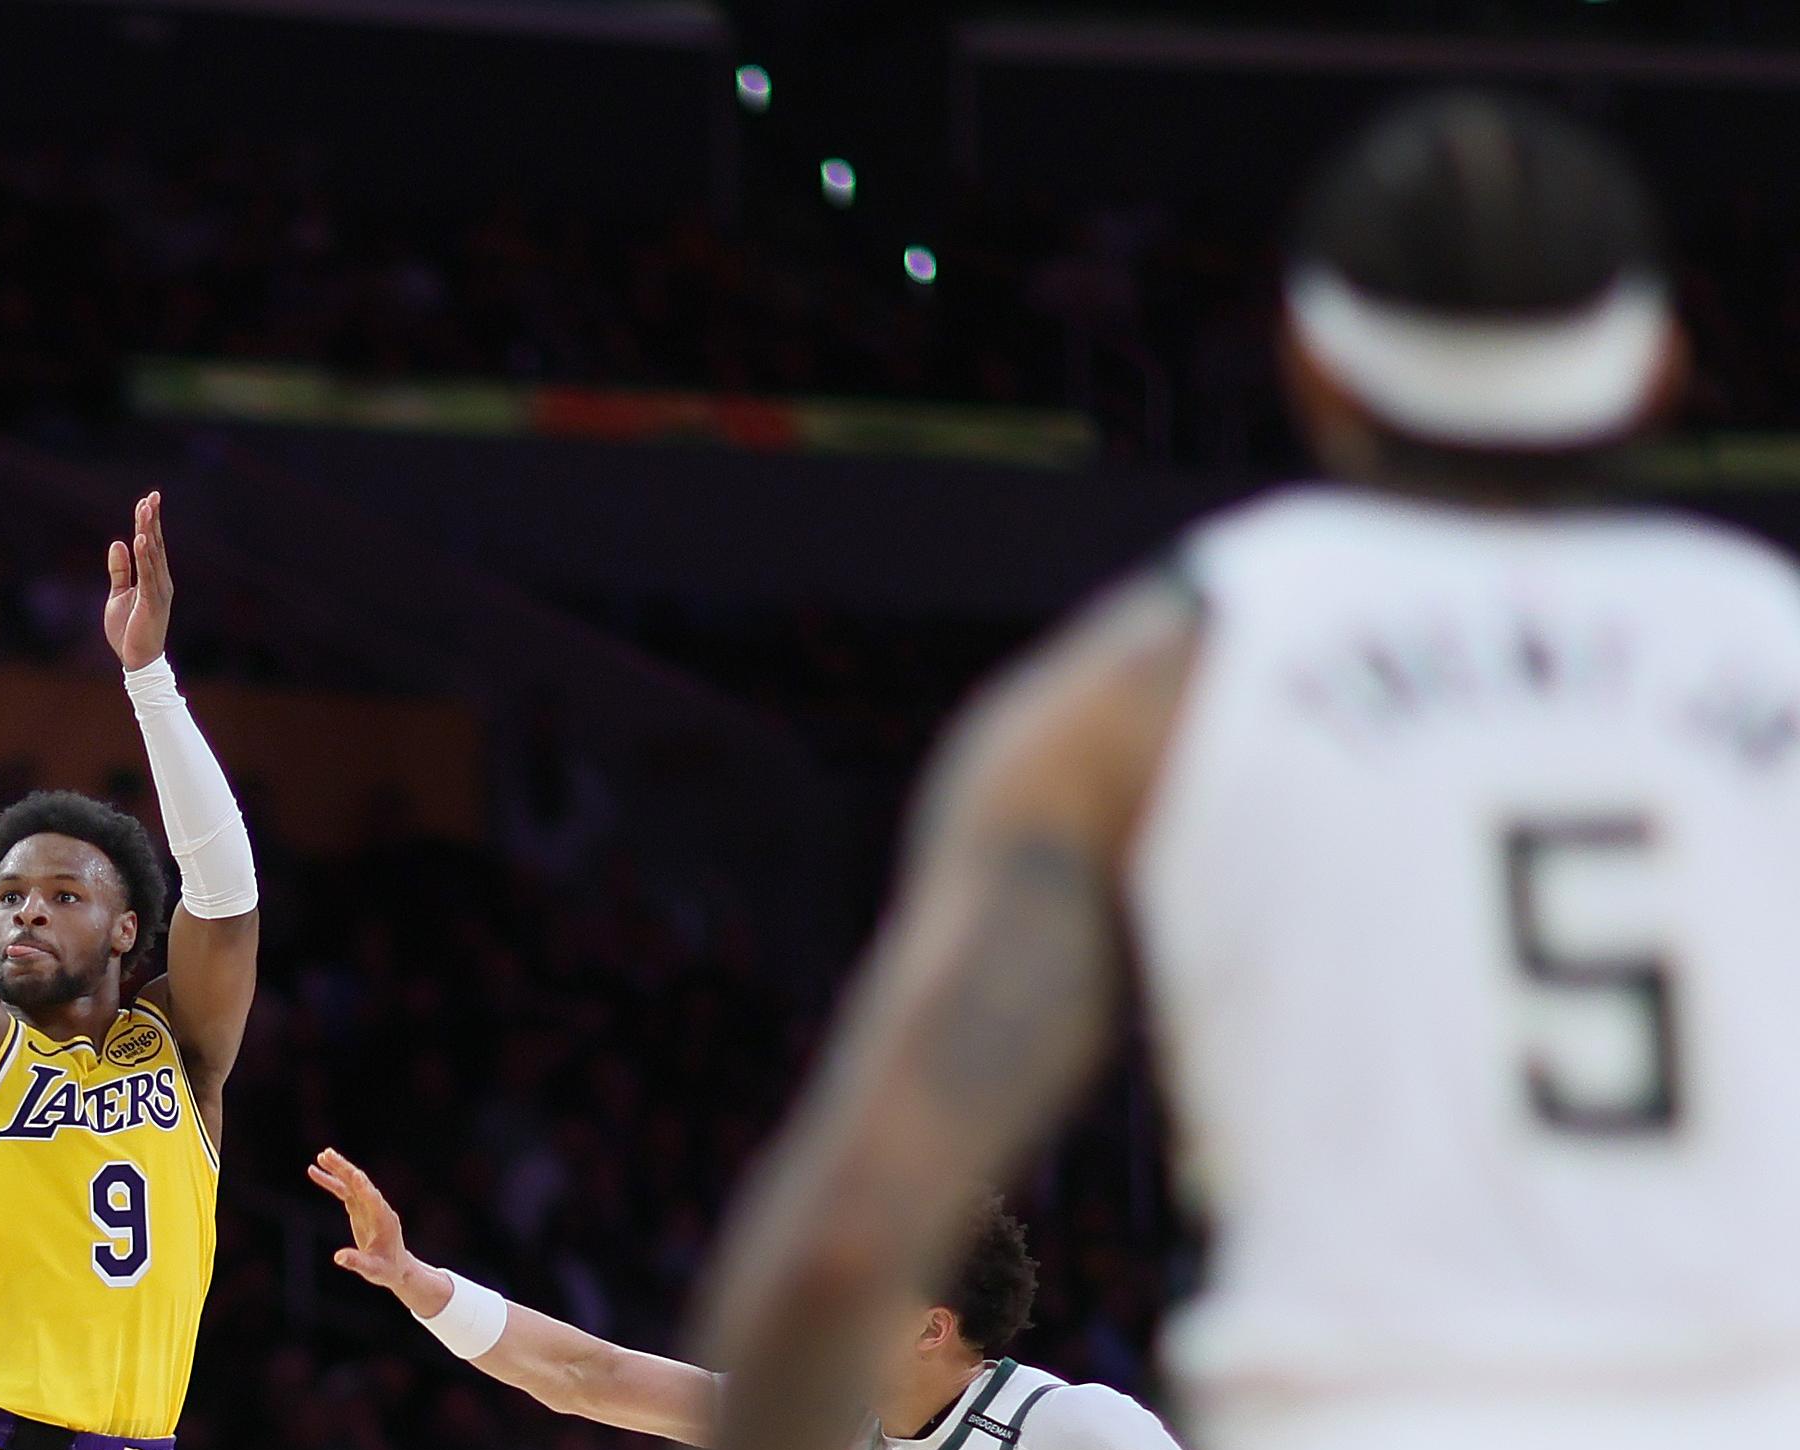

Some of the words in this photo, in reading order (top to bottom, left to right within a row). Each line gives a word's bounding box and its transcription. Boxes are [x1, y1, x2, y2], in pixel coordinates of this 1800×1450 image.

[1504, 808, 1683, 1138] 5
[109, 1030, 157, 1059] bibigo
[89, 1160, 152, 1289] 9
[968, 1413, 1014, 1439] BRIDGEMAN
